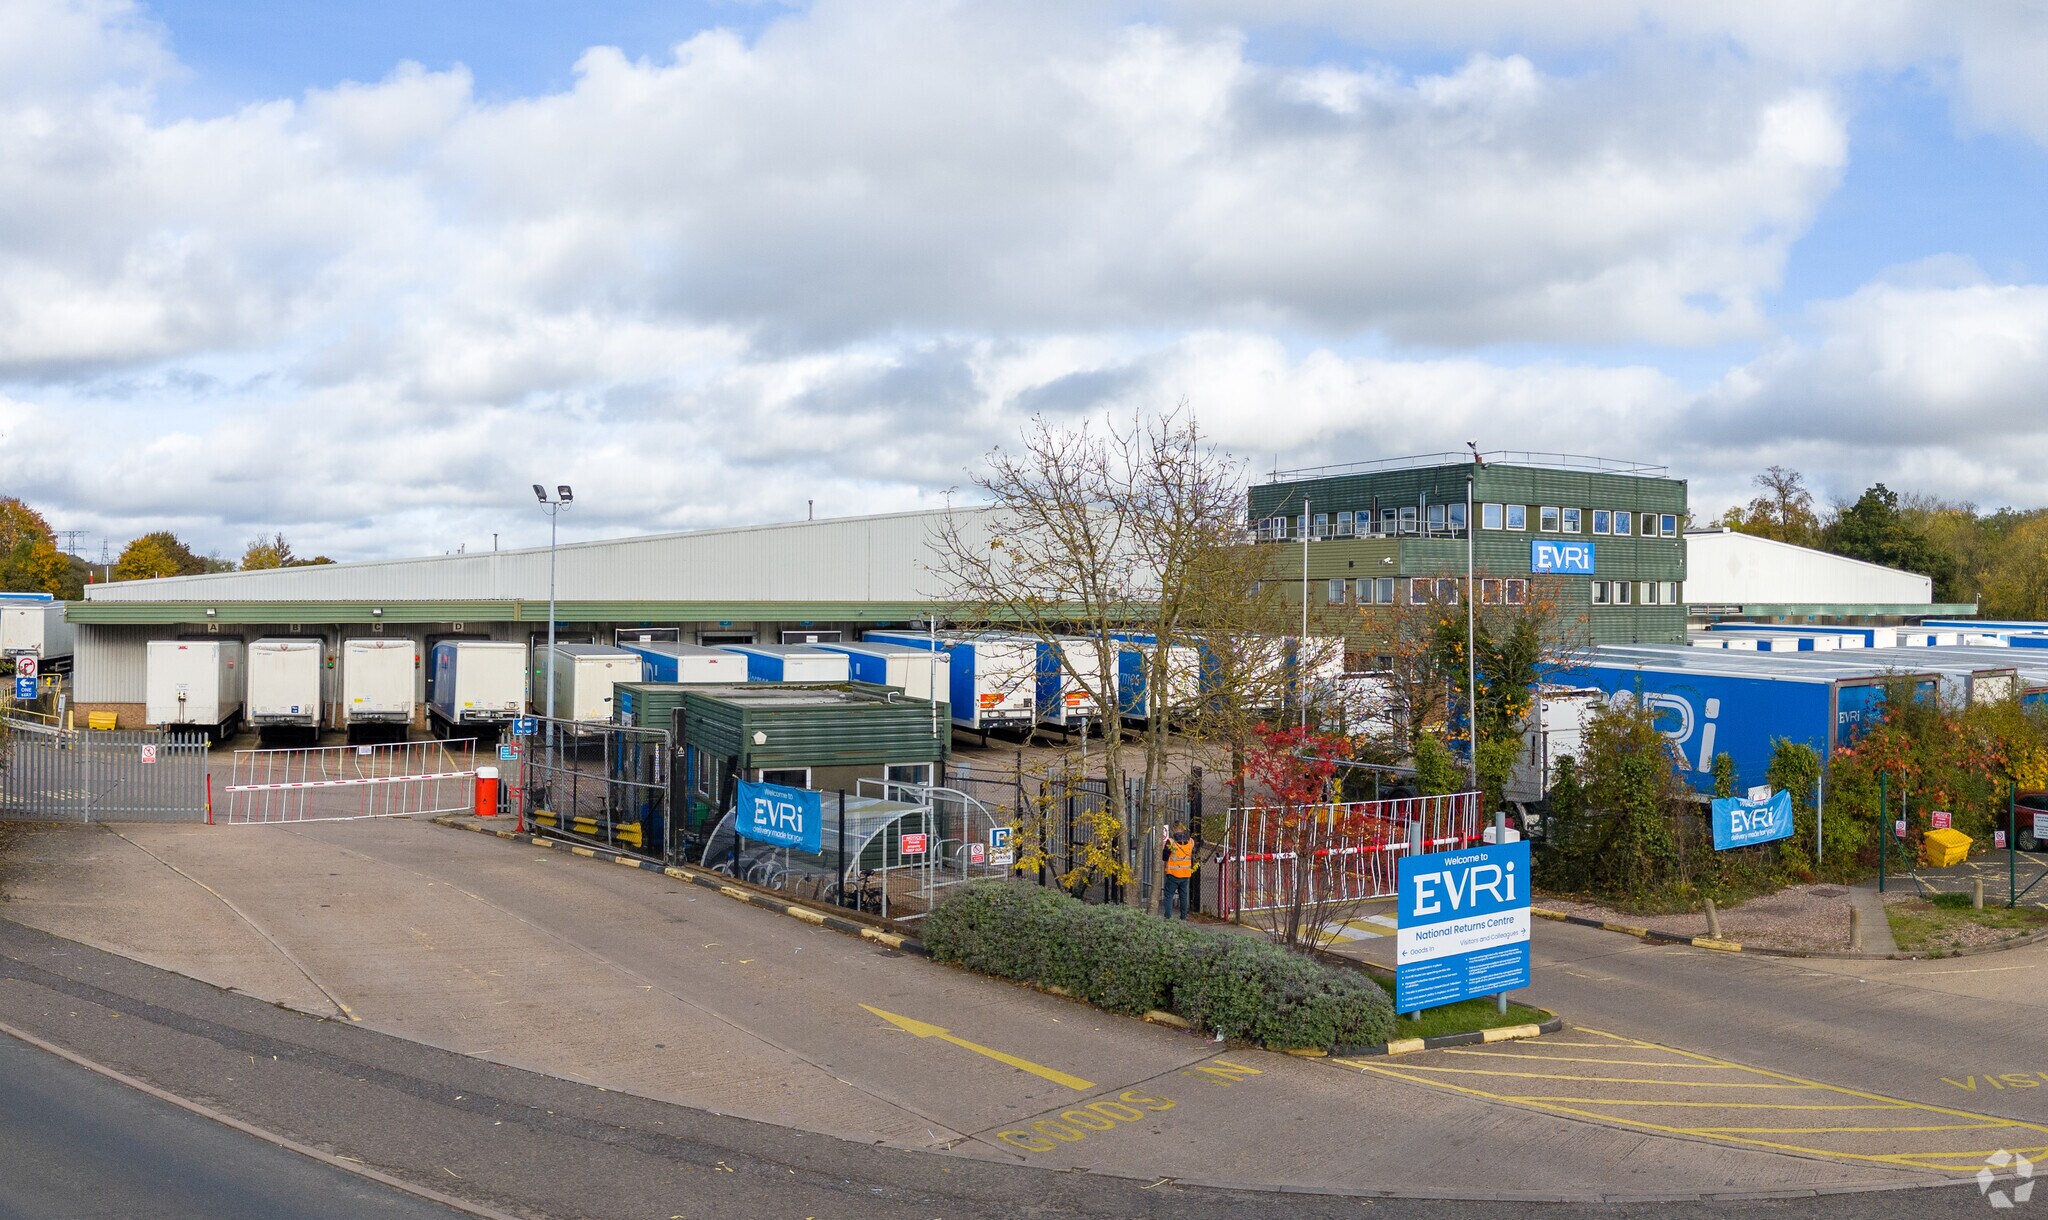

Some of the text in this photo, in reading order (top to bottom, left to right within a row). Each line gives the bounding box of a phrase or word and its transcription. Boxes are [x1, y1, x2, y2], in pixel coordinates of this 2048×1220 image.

[1538, 546, 1589, 569] EVRi
[1839, 711, 1860, 723] EVRi
[764, 789, 788, 799] Welcome
[754, 798, 802, 832] EVRi
[1731, 806, 1773, 833] EVRi
[753, 826, 772, 837] delivery
[772, 830, 786, 838] made
[1445, 853, 1488, 867] Welcome to
[1413, 861, 1516, 916] EVRi
[1416, 916, 1514, 941] National Returns Centre
[1460, 938, 1478, 946] Visitors
[1491, 930, 1518, 940] Colleagues
[1410, 947, 1428, 956] Goods
[997, 1059, 1264, 1152] GOODS IN
